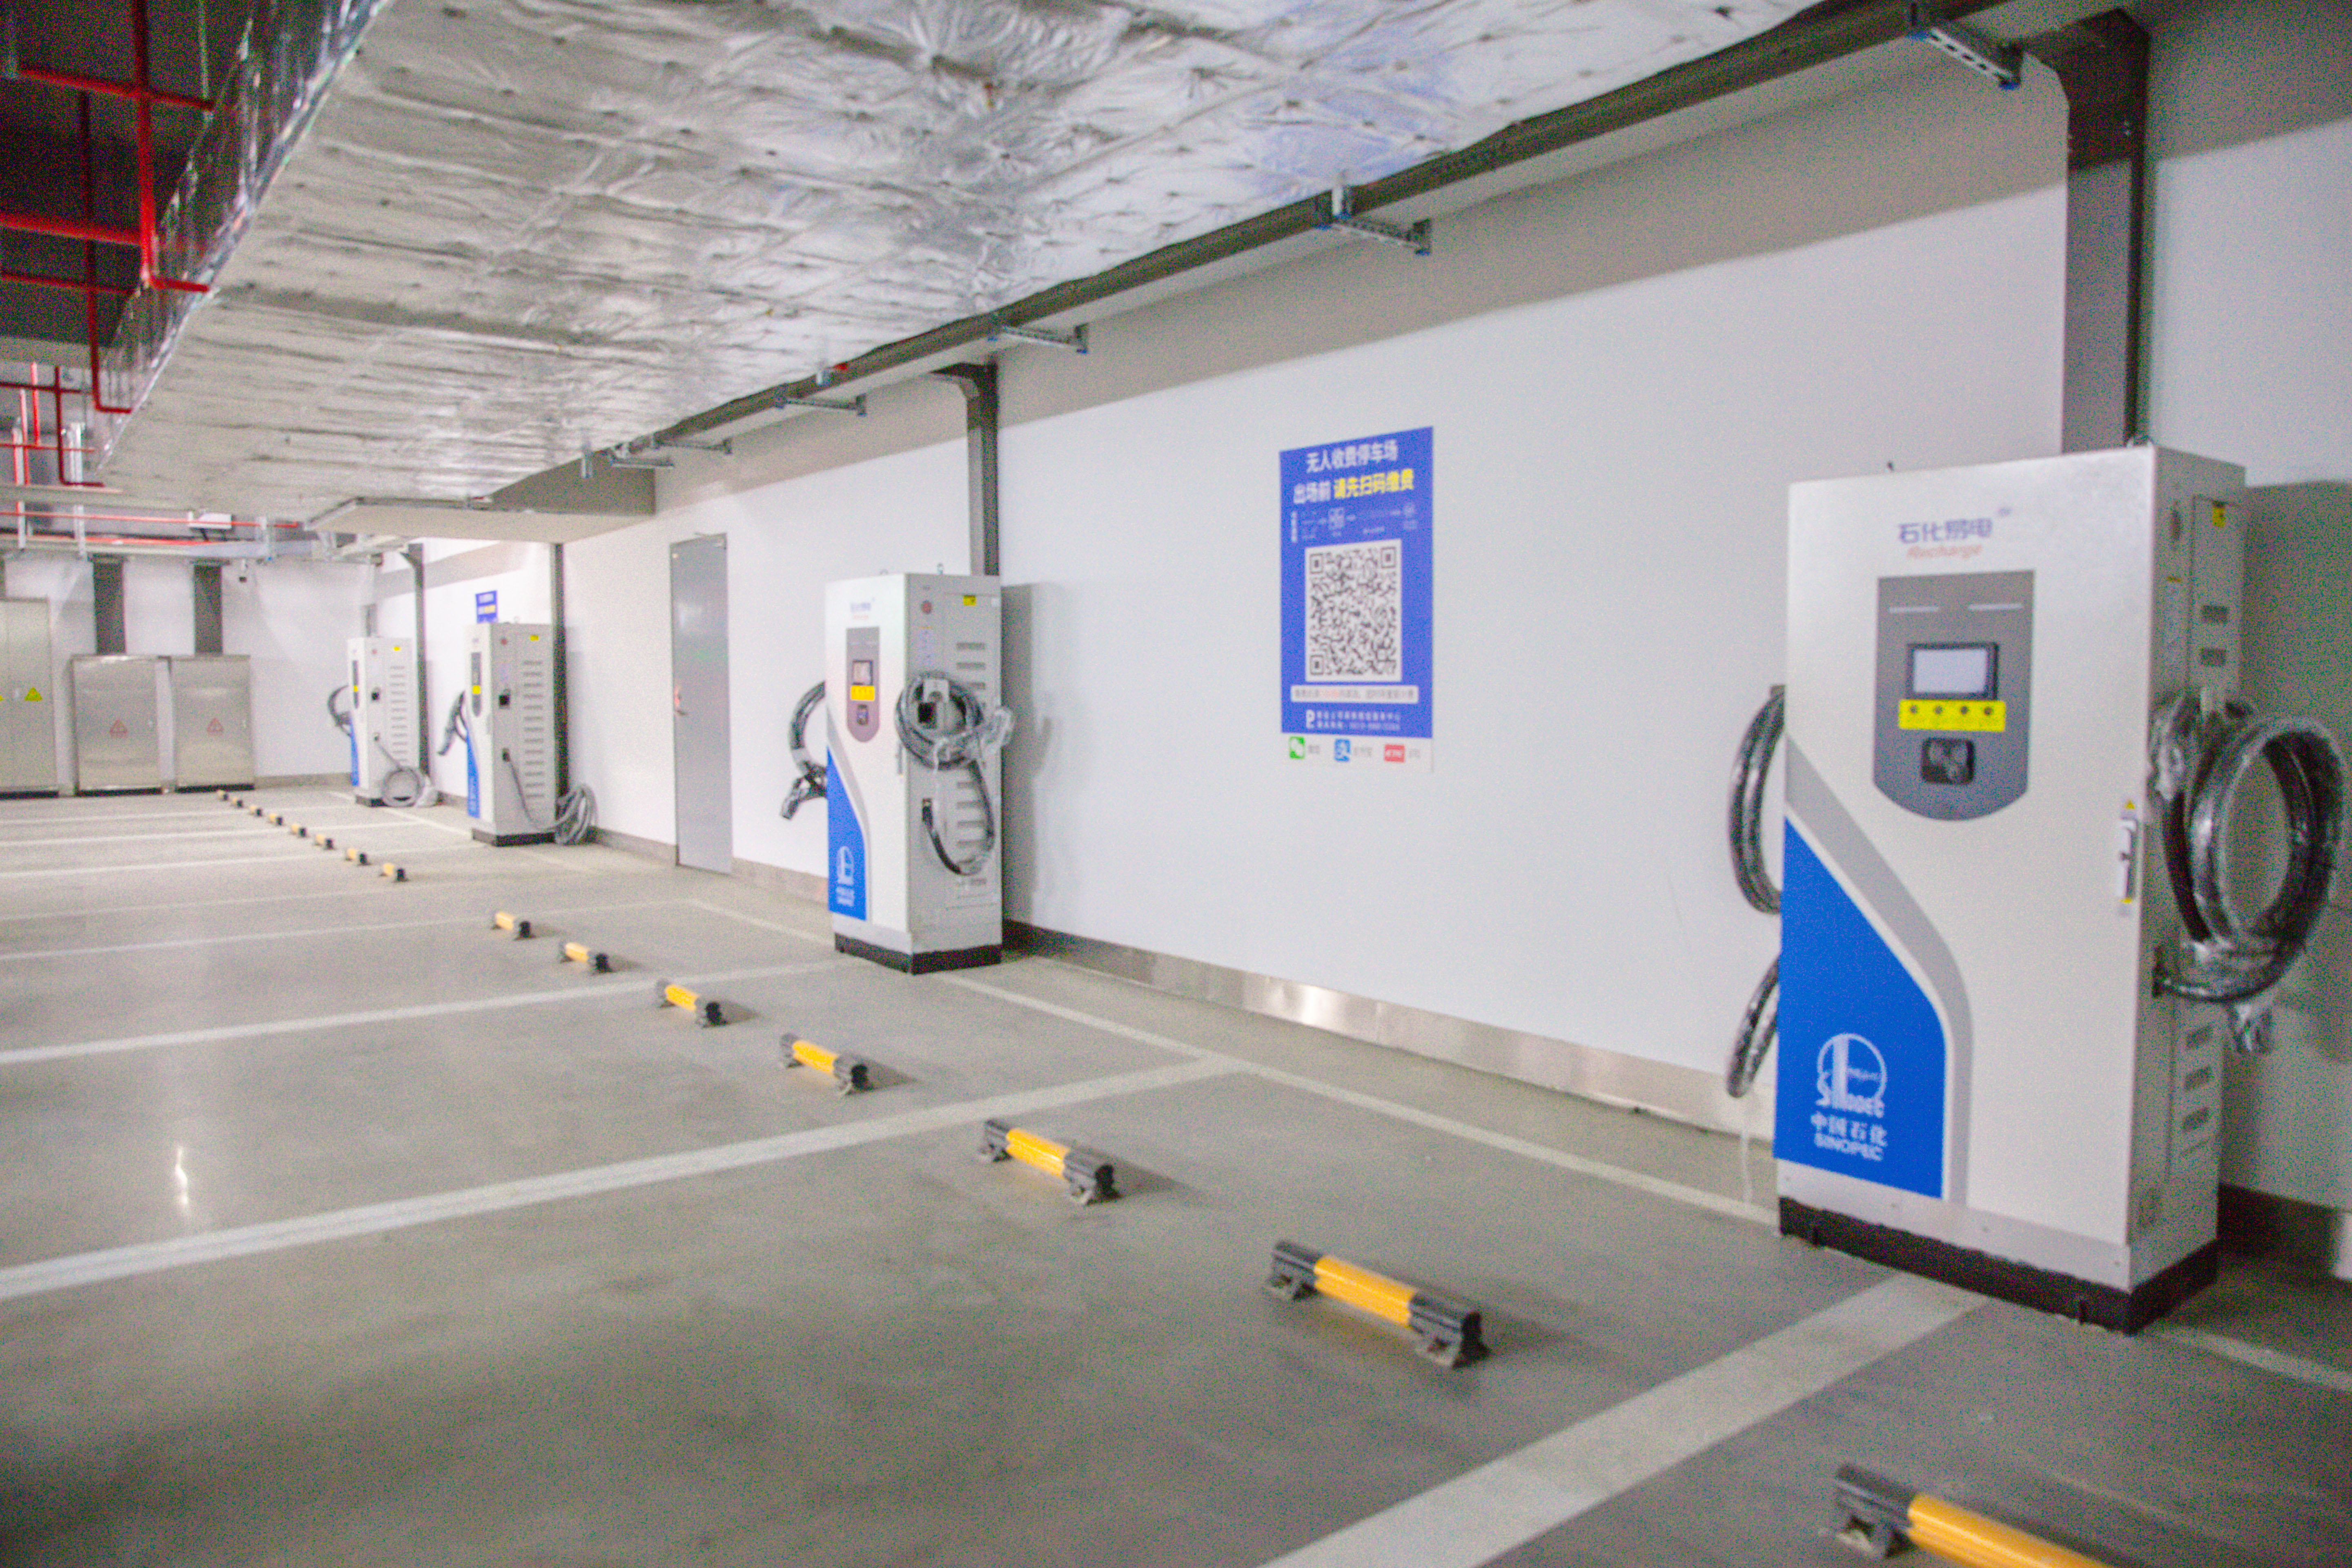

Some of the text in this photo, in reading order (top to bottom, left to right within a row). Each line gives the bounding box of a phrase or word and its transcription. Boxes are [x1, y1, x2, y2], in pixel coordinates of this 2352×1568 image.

[1307, 439, 1398, 473] 无人收费停车场
[1293, 468, 1414, 504] 出场前 请先扫码缴费
[1811, 1110, 1887, 1147] 中国石化
[1814, 1132, 1884, 1162] SINOPEC
